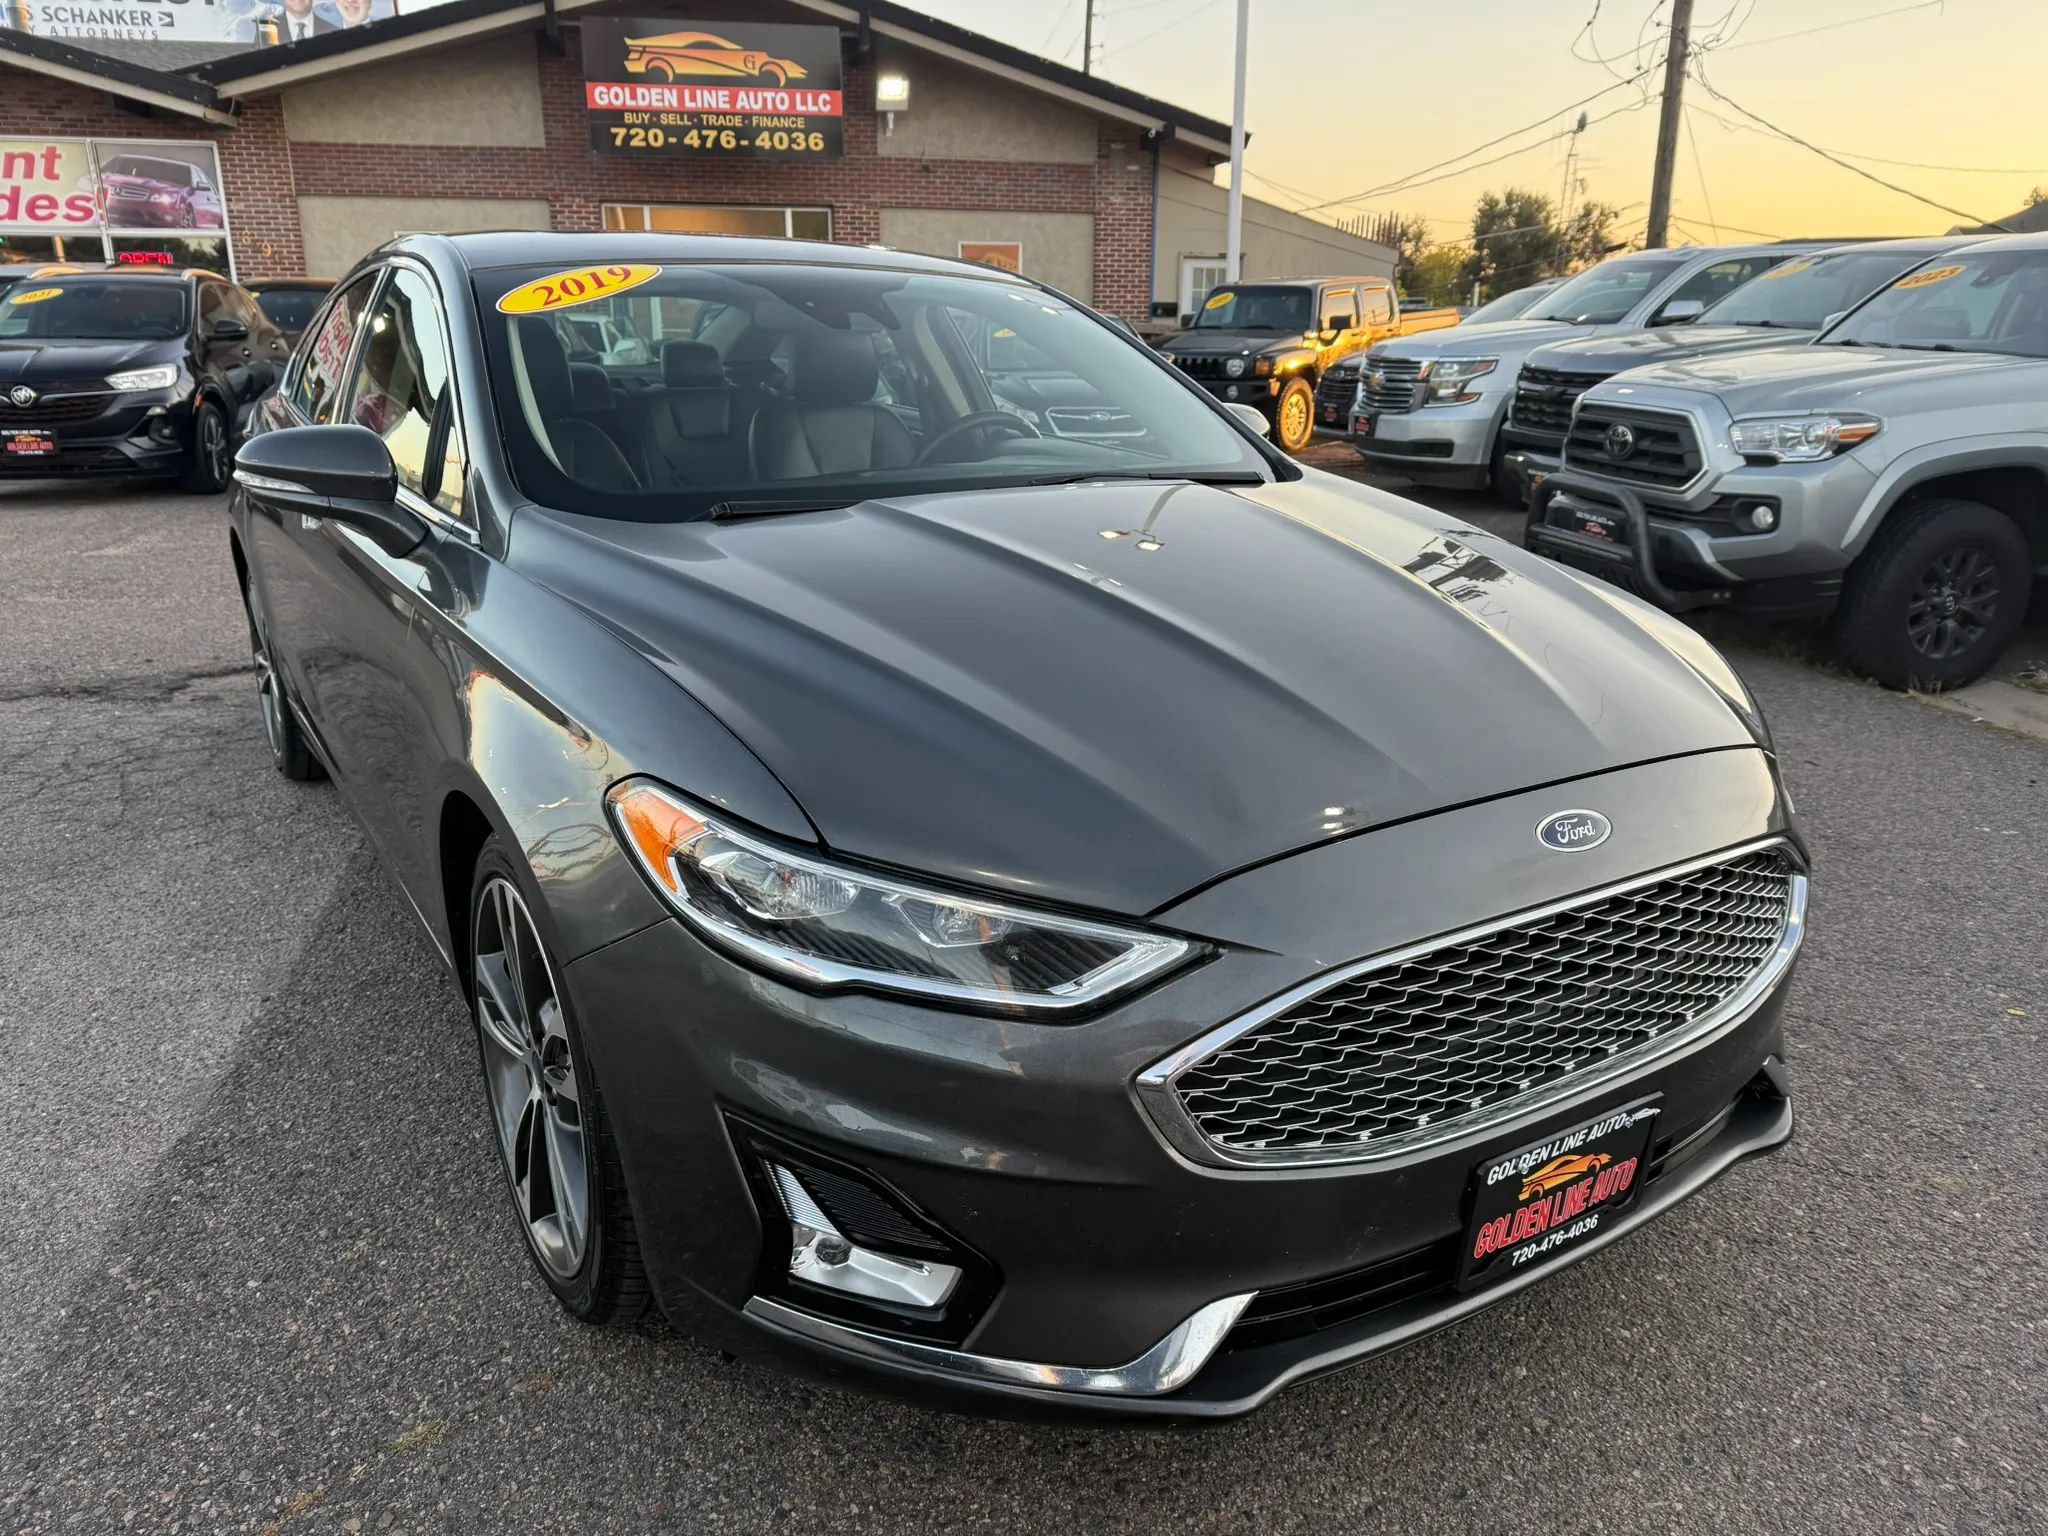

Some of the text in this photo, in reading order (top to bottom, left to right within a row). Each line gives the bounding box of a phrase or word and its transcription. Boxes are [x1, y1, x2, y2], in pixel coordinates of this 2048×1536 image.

[42, 5, 152, 27] SCHANKER
[50, 24, 159, 40] ATTORNEYS
[594, 86, 831, 112] GOLDEN LINE AUTO LLC
[624, 112, 805, 128] BUY SELL TRADE FINANCE
[532, 266, 632, 307] 2019
[1555, 817, 1596, 844] Ford
[1487, 1113, 1627, 1185] GOLDEN LINE AUTO
[1473, 1156, 1638, 1259] GOLDEN LINE AUTO
[1511, 1214, 1599, 1267] 720-476-4036
